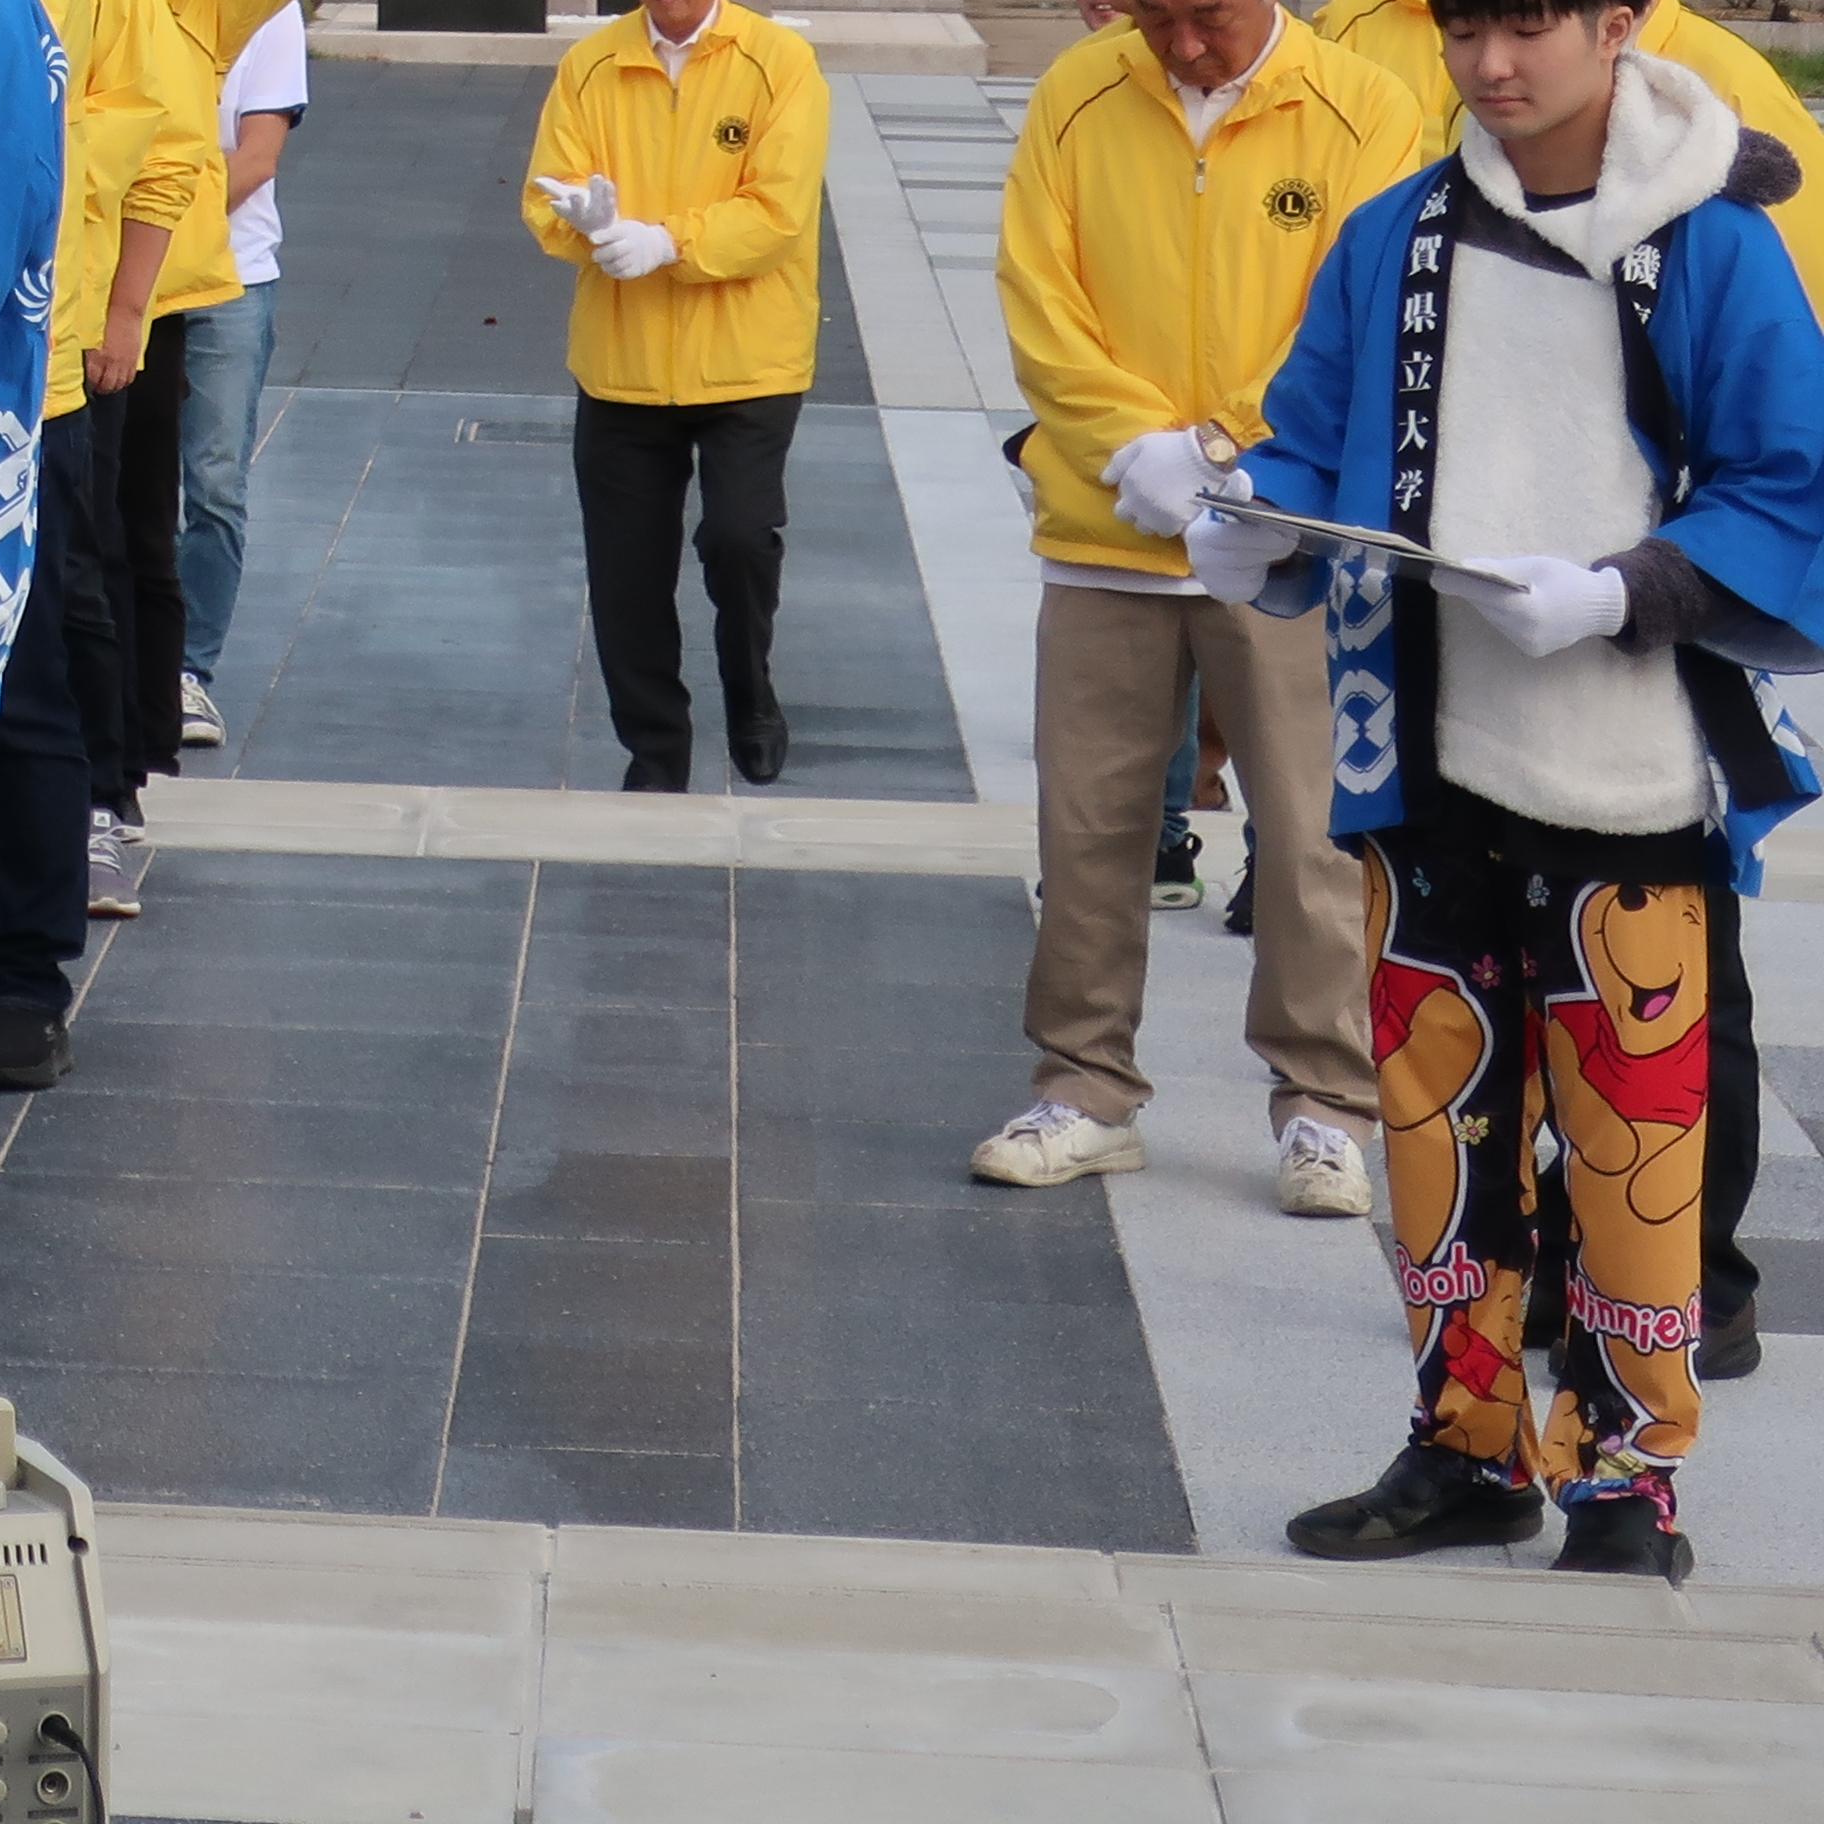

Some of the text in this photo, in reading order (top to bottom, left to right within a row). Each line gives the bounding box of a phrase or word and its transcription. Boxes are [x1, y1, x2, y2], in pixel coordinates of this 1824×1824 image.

[728, 128, 739, 141] L
[1284, 194, 1300, 214] L
[1395, 183, 1451, 511] 滋賀県立大学
